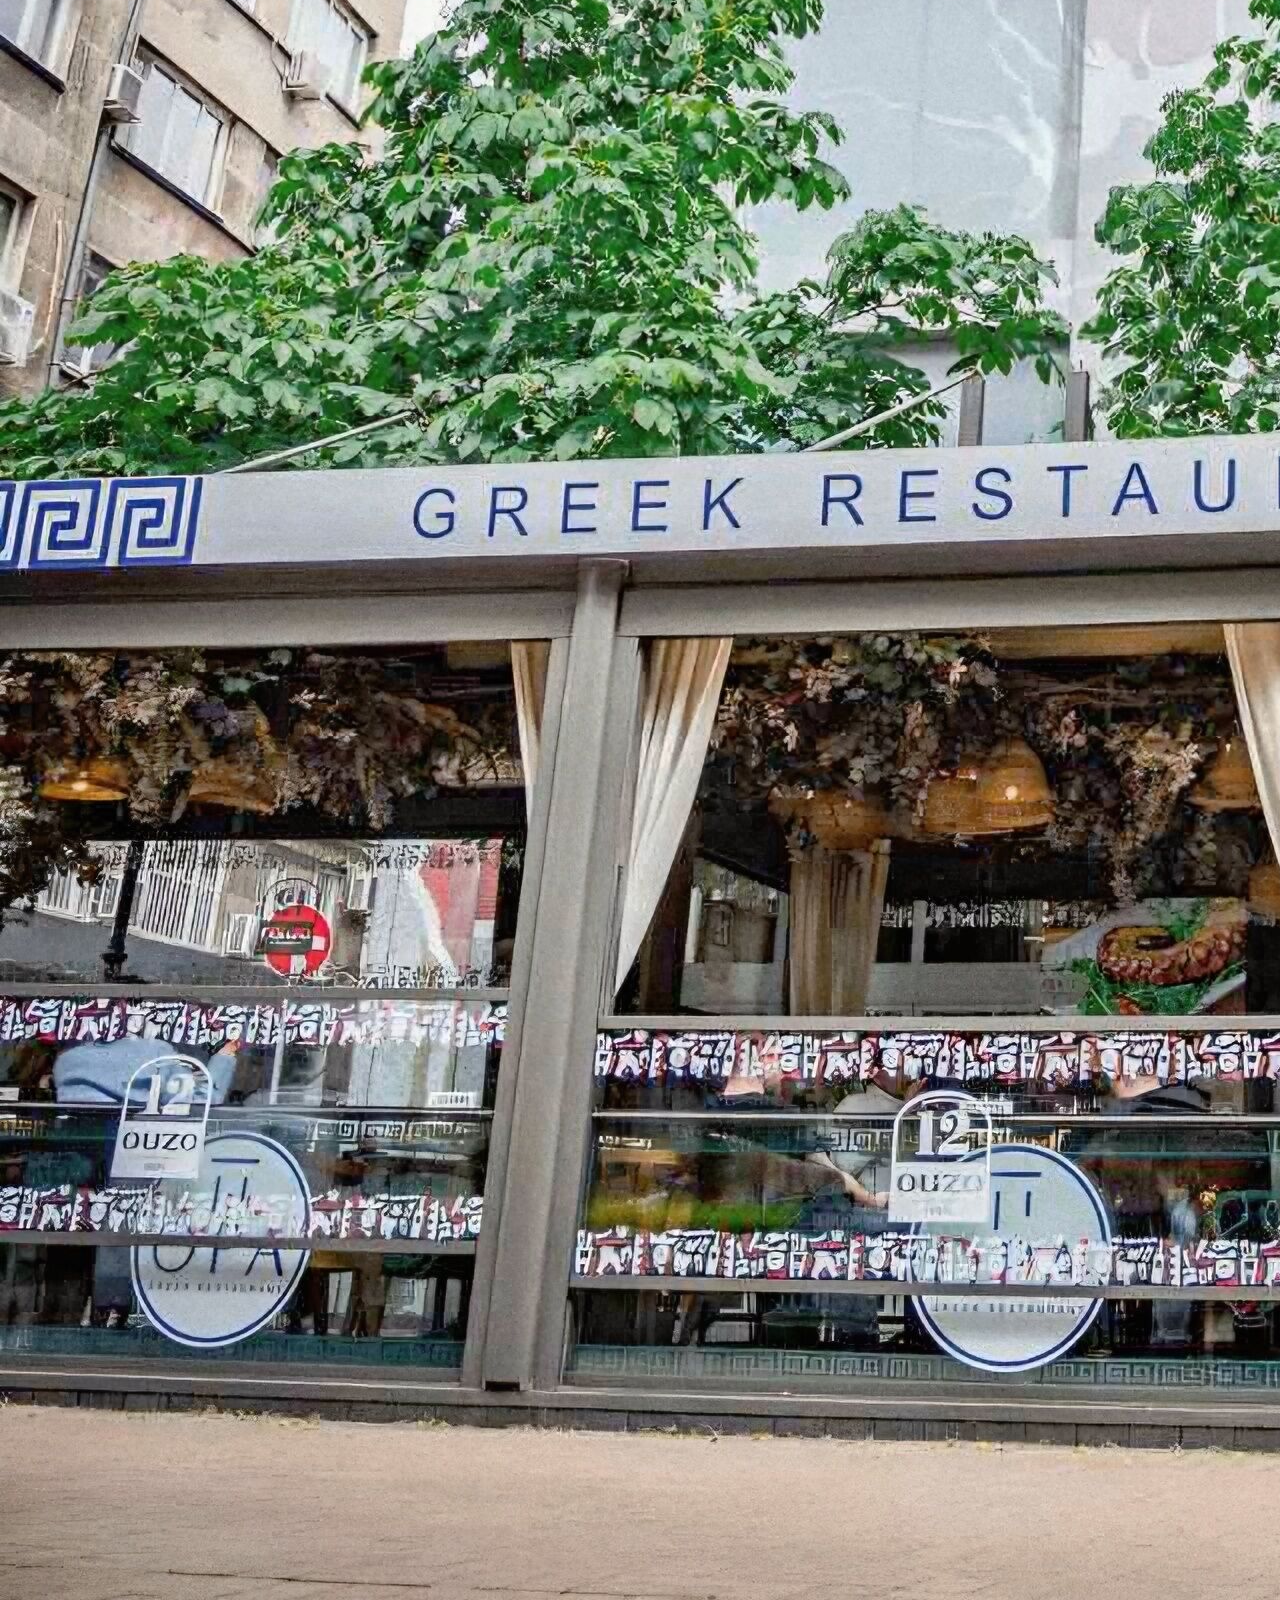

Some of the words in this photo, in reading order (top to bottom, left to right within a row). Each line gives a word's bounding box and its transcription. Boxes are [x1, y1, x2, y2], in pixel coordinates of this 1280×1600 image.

[412, 477, 744, 539] GREEK
[136, 1073, 196, 1116] 12
[122, 1131, 198, 1151] OUZO
[915, 1109, 972, 1156] 12
[896, 1172, 983, 1194] OUZO
